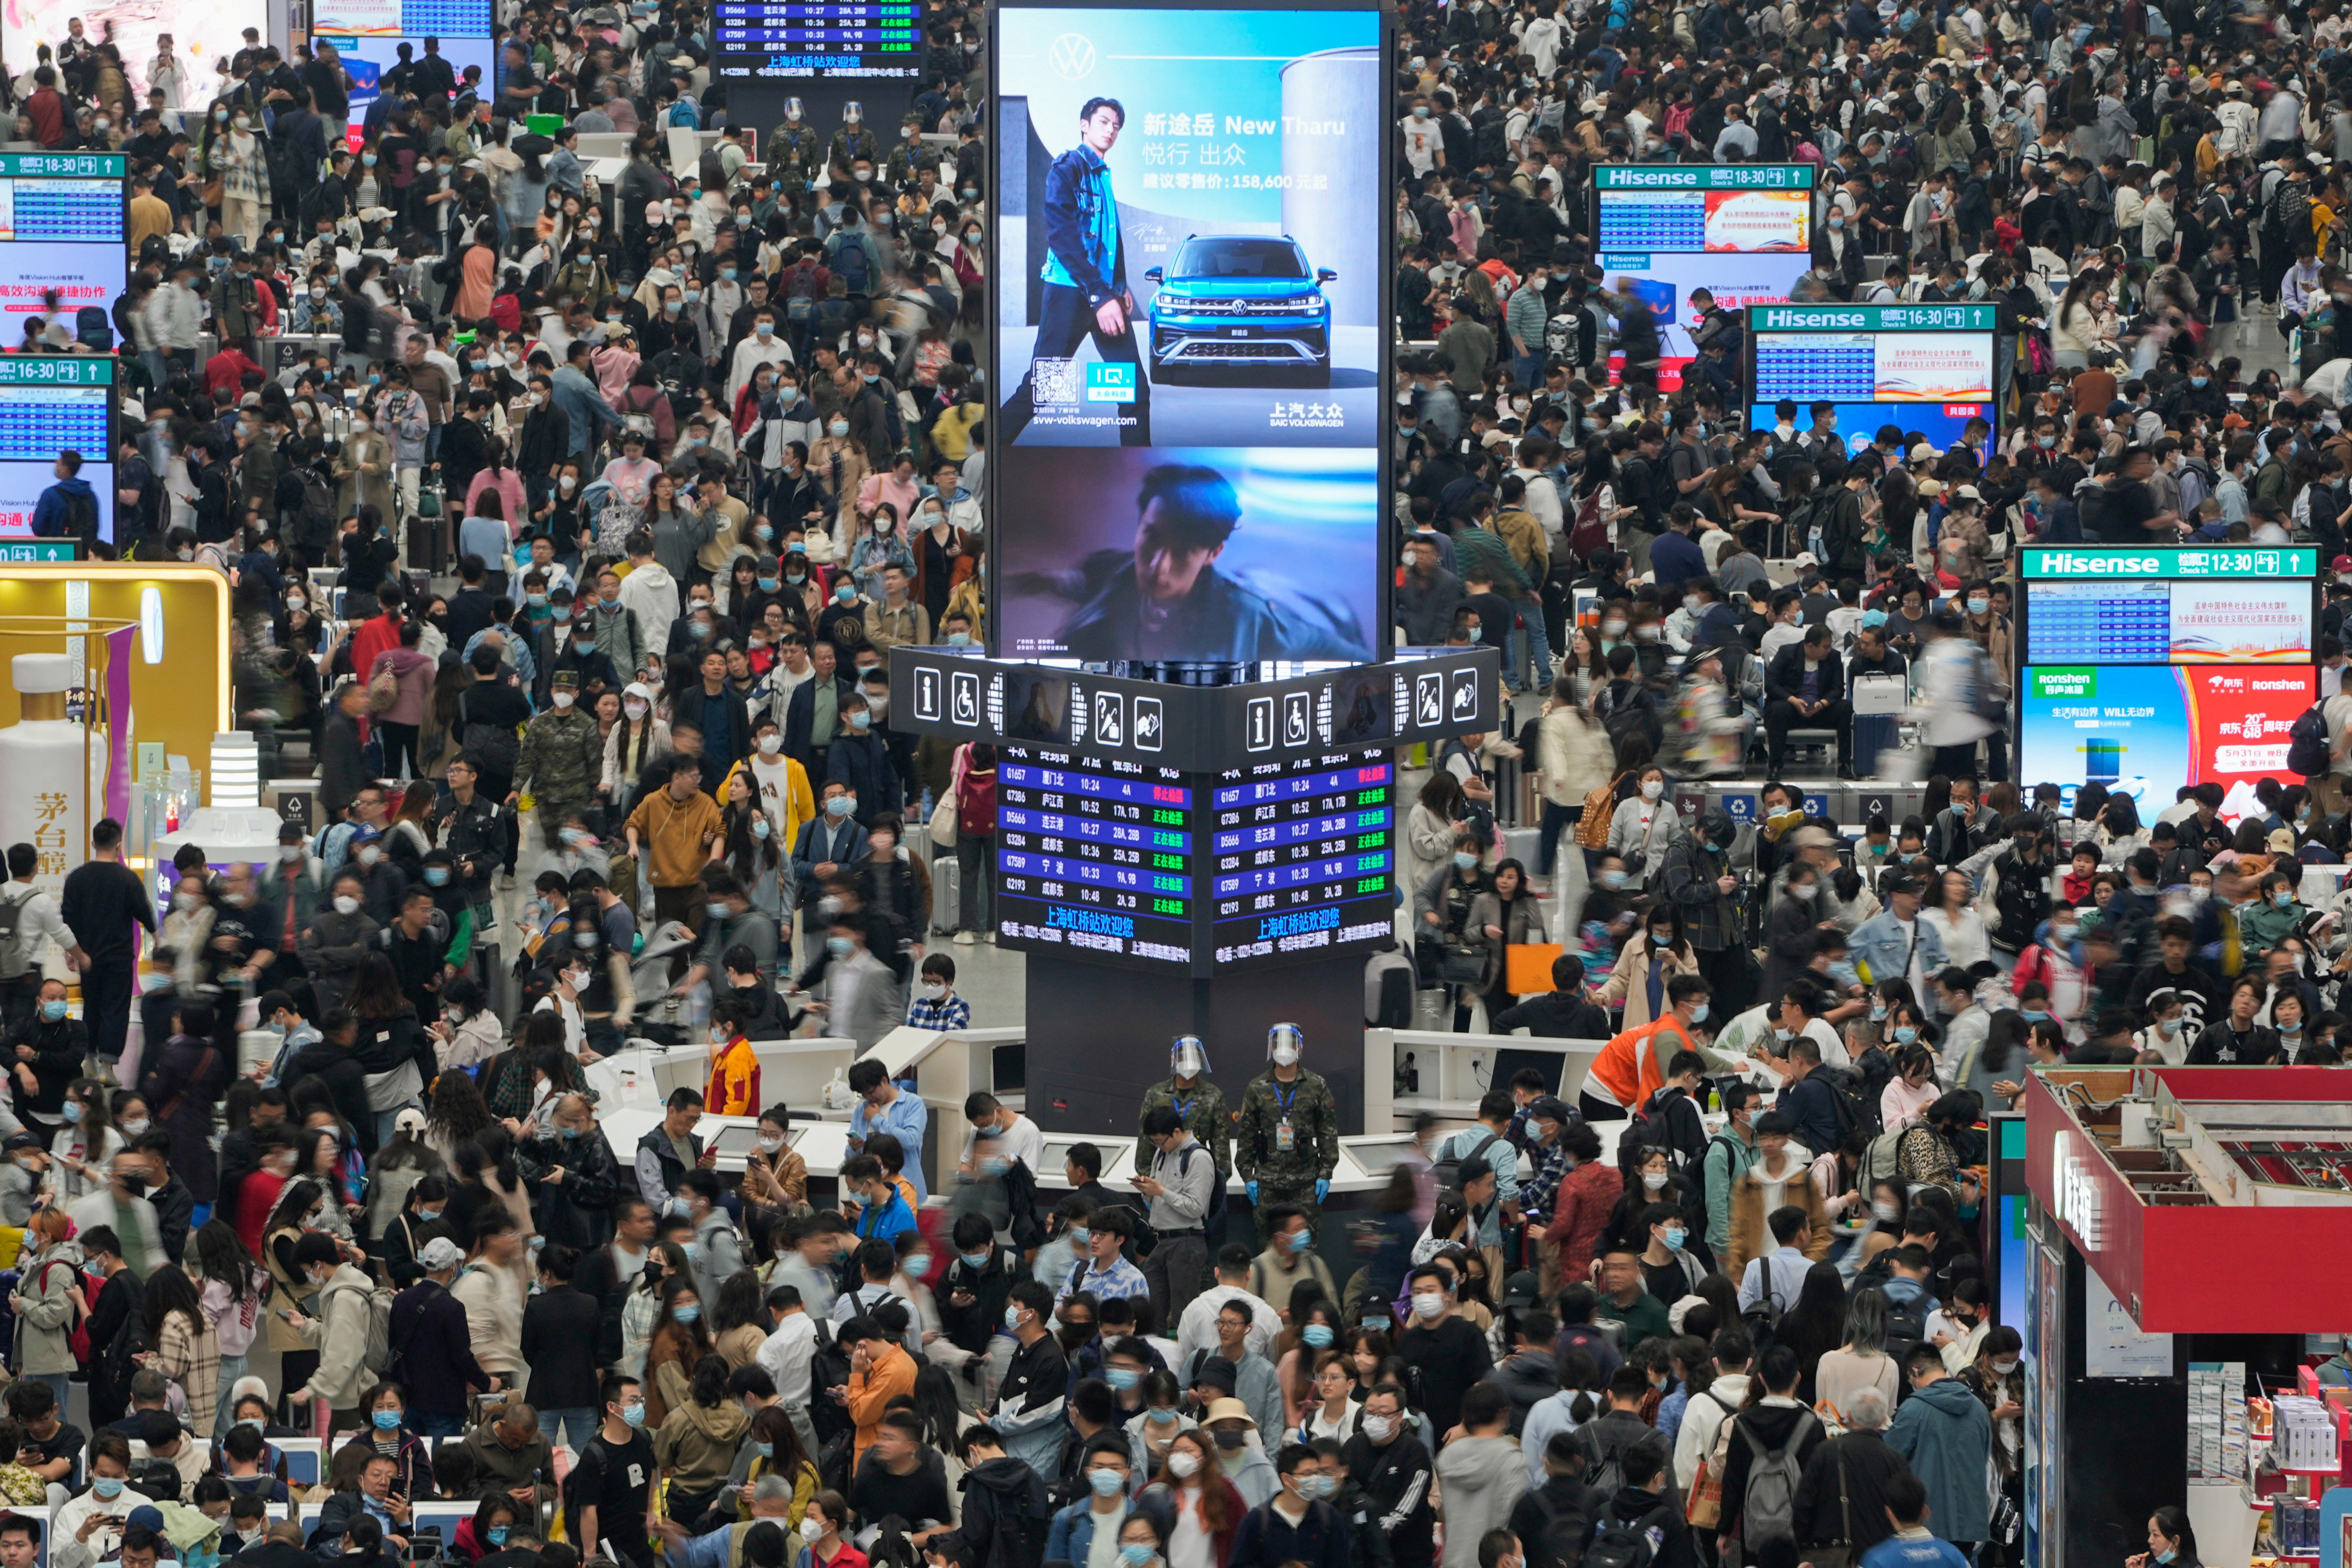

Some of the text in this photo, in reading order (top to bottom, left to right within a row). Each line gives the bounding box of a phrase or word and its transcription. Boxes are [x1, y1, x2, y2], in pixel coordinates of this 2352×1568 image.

[880, 6, 911, 15] 正在检票
[880, 18, 911, 27] 正在检票
[881, 30, 911, 39] 正在检票
[881, 42, 912, 51] 正在检票
[767, 56, 860, 68] 上海虹桥站欢迎您
[1144, 113, 1346, 137] 新途岳 New Tharu
[19, 157, 43, 168] 检票口
[45, 158, 76, 172] 18-30
[1143, 143, 1246, 166] 悦行 出众
[1610, 169, 1765, 185] Hisense 检票口 18-30
[1767, 309, 1941, 326] Hisense 检票口 16-30
[18, 363, 55, 378] 16-30
[1033, 415, 1137, 427] svw-volkswagen.com
[1270, 402, 1343, 419] 上汽大众
[2042, 553, 2252, 573] Hisense 检票口 12-30
[2194, 602, 2287, 610] 高举中国特色社会主义伟大旗帜
[2039, 674, 2090, 684] Ronshen
[2045, 685, 2083, 694] 容声冰箱
[2224, 678, 2305, 690] 京东 Ronshen
[2052, 707, 2154, 719] 生活有边界 WILL无边界
[2220, 723, 2241, 734] 京东
[2242, 727, 2262, 739] 618
[1007, 767, 1025, 781] G1657
[1081, 779, 1100, 791] 10:24
[1122, 784, 1131, 796] 4A
[1153, 786, 1183, 804] 停止检票
[1221, 789, 1239, 803] G1657
[1292, 780, 1309, 793] 10:24
[1330, 775, 1338, 787] 4A
[1358, 766, 1385, 783] 停止检票
[1007, 789, 1025, 803] G7386
[1081, 800, 1099, 814] 10:52
[1153, 809, 1183, 826] 正在检票
[1221, 812, 1239, 825] G7386
[1292, 802, 1309, 815] 10:52
[1358, 788, 1385, 805] 正在检票
[33, 793, 68, 876] 茅台醇
[1007, 811, 1025, 825] D5666
[1081, 822, 1099, 836] 10:27
[1153, 831, 1183, 848] 正在检票
[1221, 834, 1239, 848] D5666
[1291, 823, 1309, 836] 10:27
[1358, 810, 1384, 827] 正在检票
[1007, 833, 1025, 847] G3284
[1081, 844, 1100, 858] 10:36
[1153, 853, 1183, 870] 正在检票
[1221, 856, 1239, 870] G3284
[1291, 845, 1309, 859] 10:36
[1358, 831, 1384, 849] 正在检票
[1007, 855, 1183, 892] G7589 10:33 正在检票
[1221, 853, 1384, 892] G7589 10:33 正在检票
[1007, 877, 1025, 891] G2193
[1081, 889, 1100, 902] 10:48
[1153, 899, 1183, 915] 正在检票
[1221, 901, 1239, 915] G2193
[1291, 890, 1309, 903] 10:48
[1358, 876, 1384, 893] 正在检票
[1045, 906, 1134, 939] 上海虹桥站欢迎您
[1257, 907, 1340, 939] 上海虹桥站欢迎您
[627, 1463, 645, 1488] R
